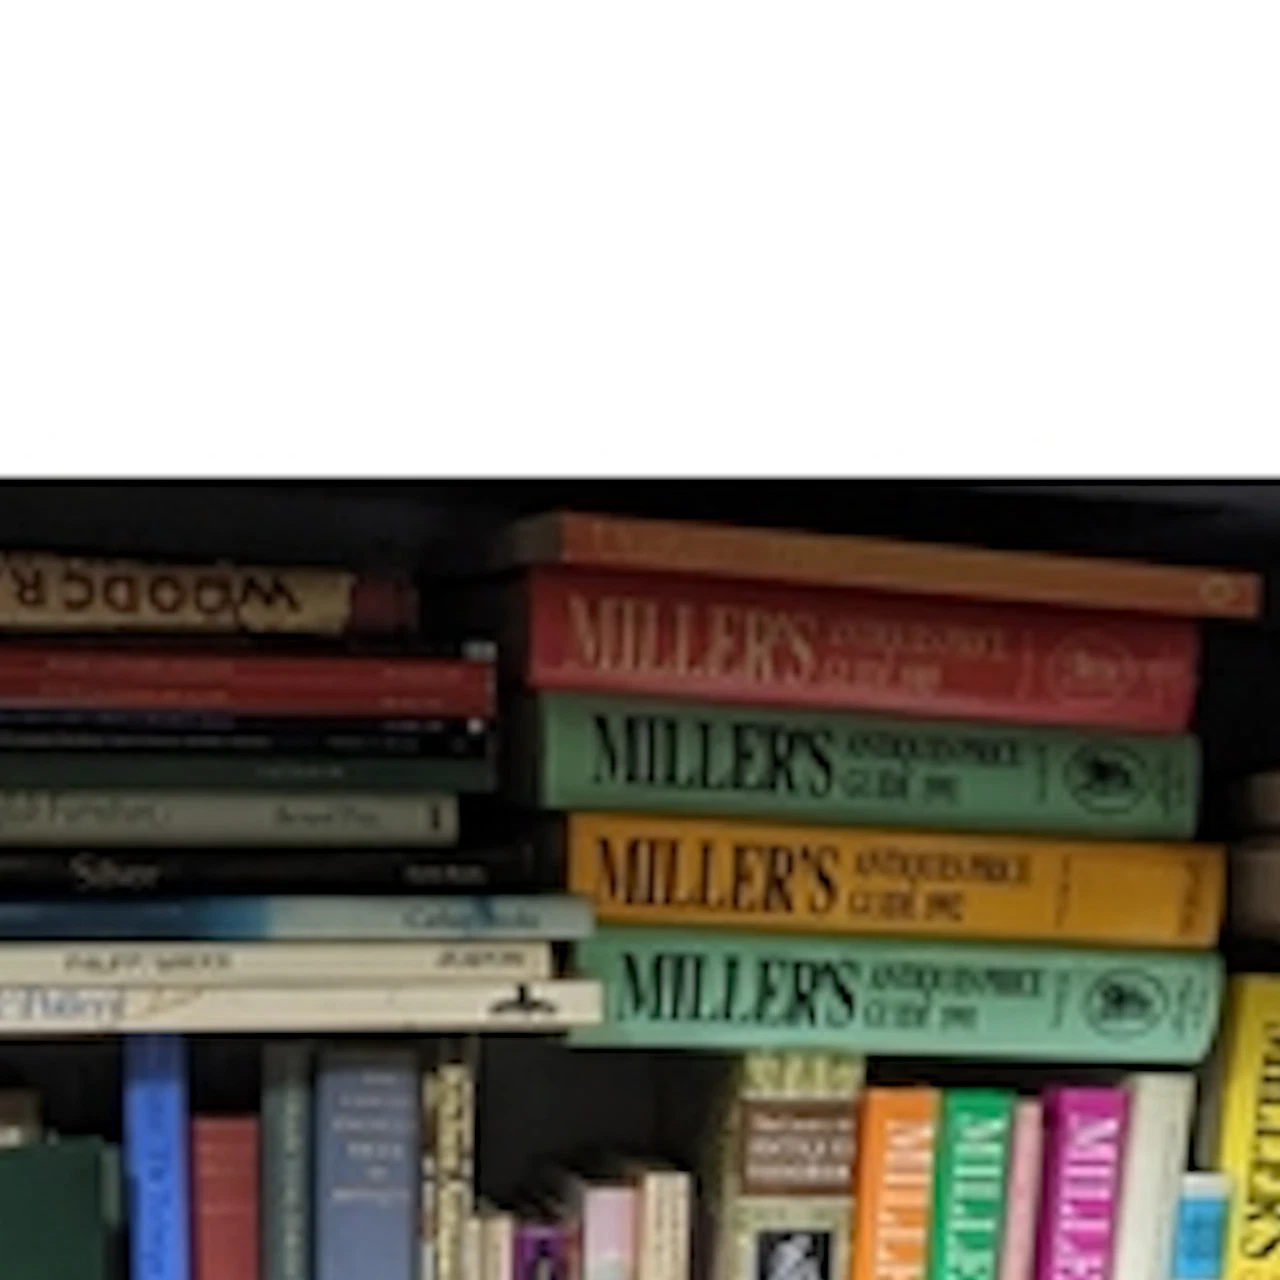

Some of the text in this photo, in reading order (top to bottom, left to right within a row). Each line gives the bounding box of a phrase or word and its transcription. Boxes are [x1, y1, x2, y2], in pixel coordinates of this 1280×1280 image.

[566, 592, 818, 684] MILLER'S
[590, 712, 835, 797] MILLER'S
[596, 836, 842, 916] MILLER'S
[621, 952, 859, 1028] MILLER'S
